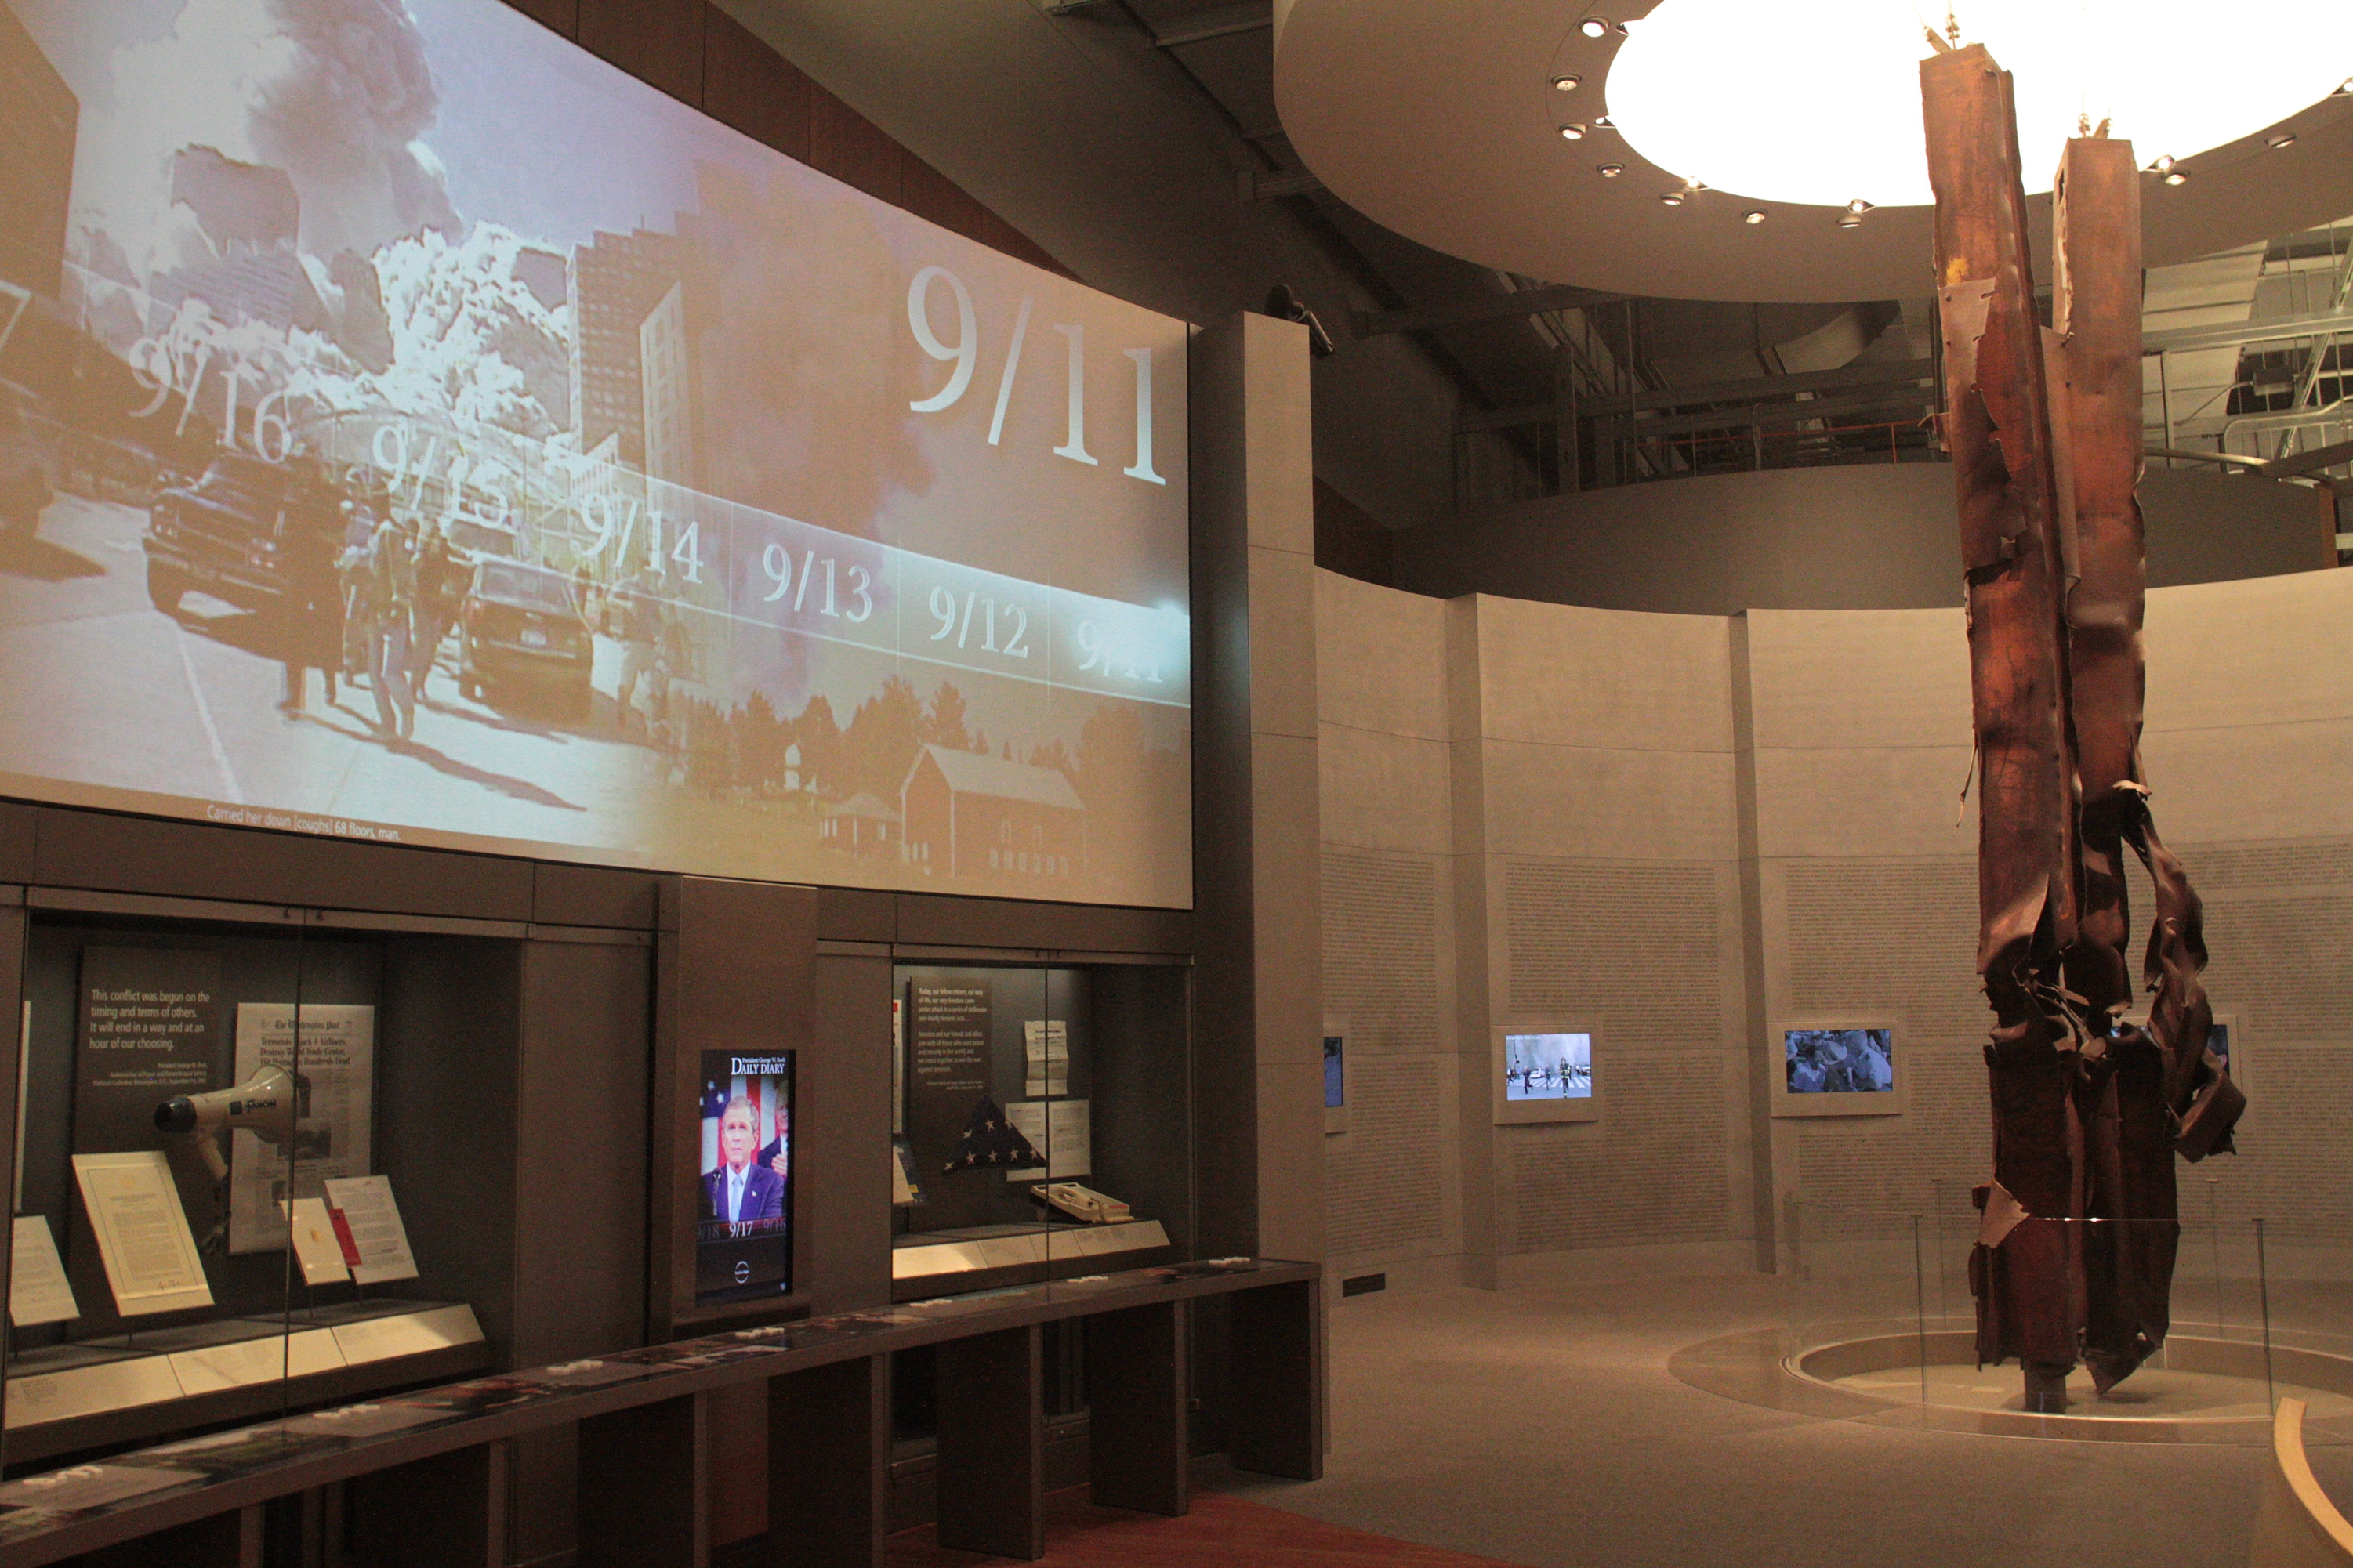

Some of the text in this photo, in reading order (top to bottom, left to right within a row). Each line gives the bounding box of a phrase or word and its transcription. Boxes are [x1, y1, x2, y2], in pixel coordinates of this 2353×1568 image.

[908, 266, 1166, 485] 9/11
[129, 337, 292, 463] 9/16
[581, 493, 704, 584] 9/14
[763, 543, 872, 623] 9/13
[930, 586, 1029, 658] 9/12
[207, 805, 401, 841] Carried her down [coughs] 68 floors, man.
[92, 988, 210, 1004] This conflict was begun on the
[91, 1005, 198, 1019] timing and terms of others.
[90, 1022, 96, 1032] It
[99, 1021, 114, 1032] will
[115, 1022, 131, 1032] end
[133, 1022, 141, 1032] in
[150, 1024, 167, 1035] way
[168, 1022, 183, 1033] and
[184, 1023, 193, 1032] at
[194, 1023, 205, 1032] an
[89, 1037, 175, 1052] hour of our choosing.
[731, 1058, 785, 1075] DAILY DIARY
[729, 1221, 753, 1238] 9/17
[763, 1217, 786, 1234] 9/16
